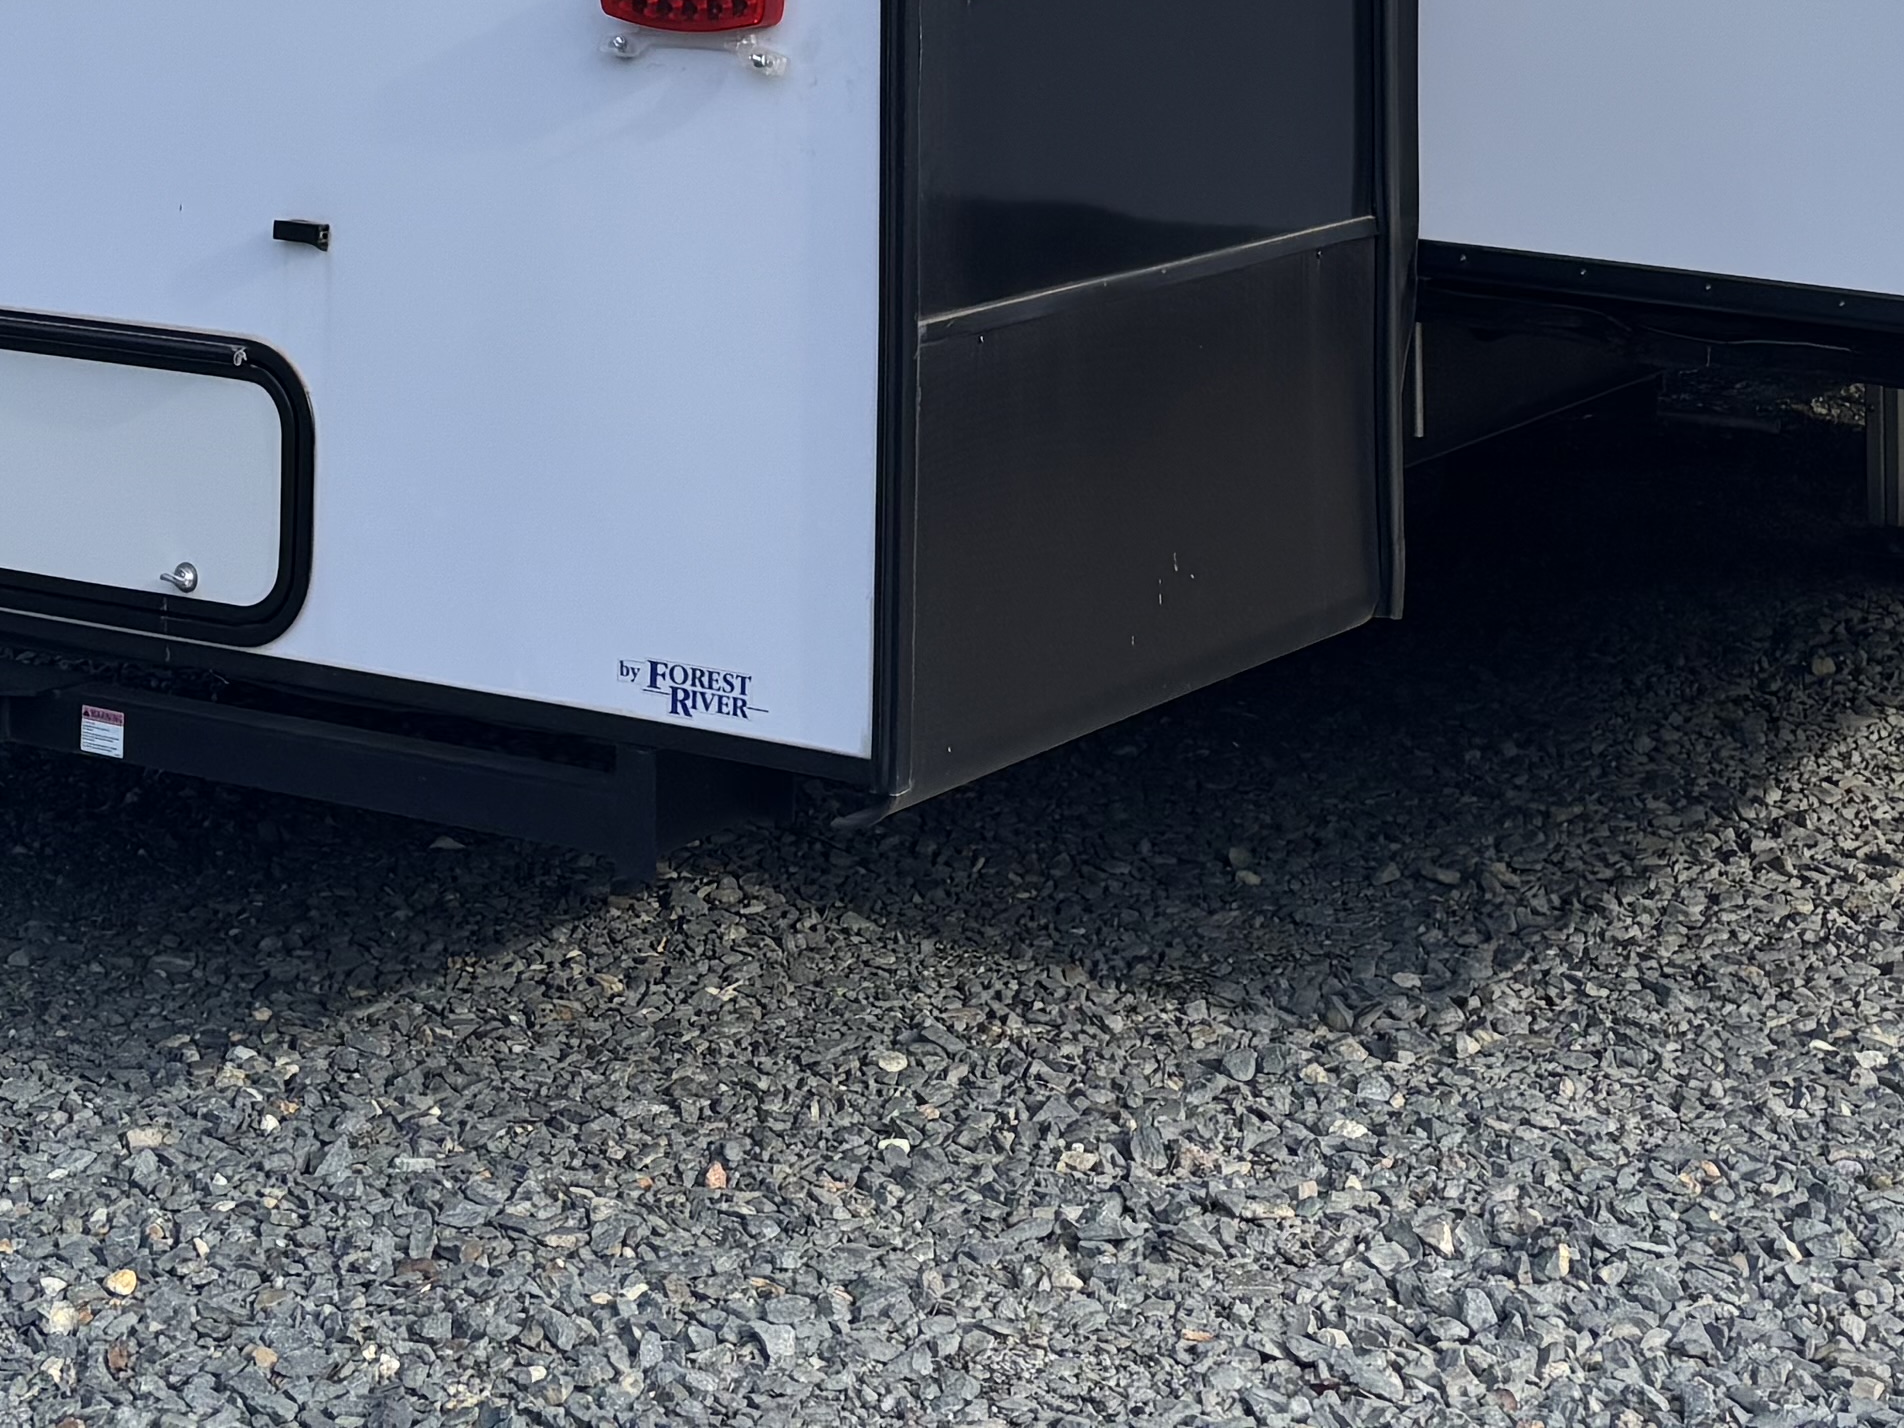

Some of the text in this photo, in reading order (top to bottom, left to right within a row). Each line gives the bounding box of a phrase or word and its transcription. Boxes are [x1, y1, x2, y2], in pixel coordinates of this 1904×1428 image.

[619, 660, 752, 696] by FOREST
[669, 686, 749, 720] RIVER
